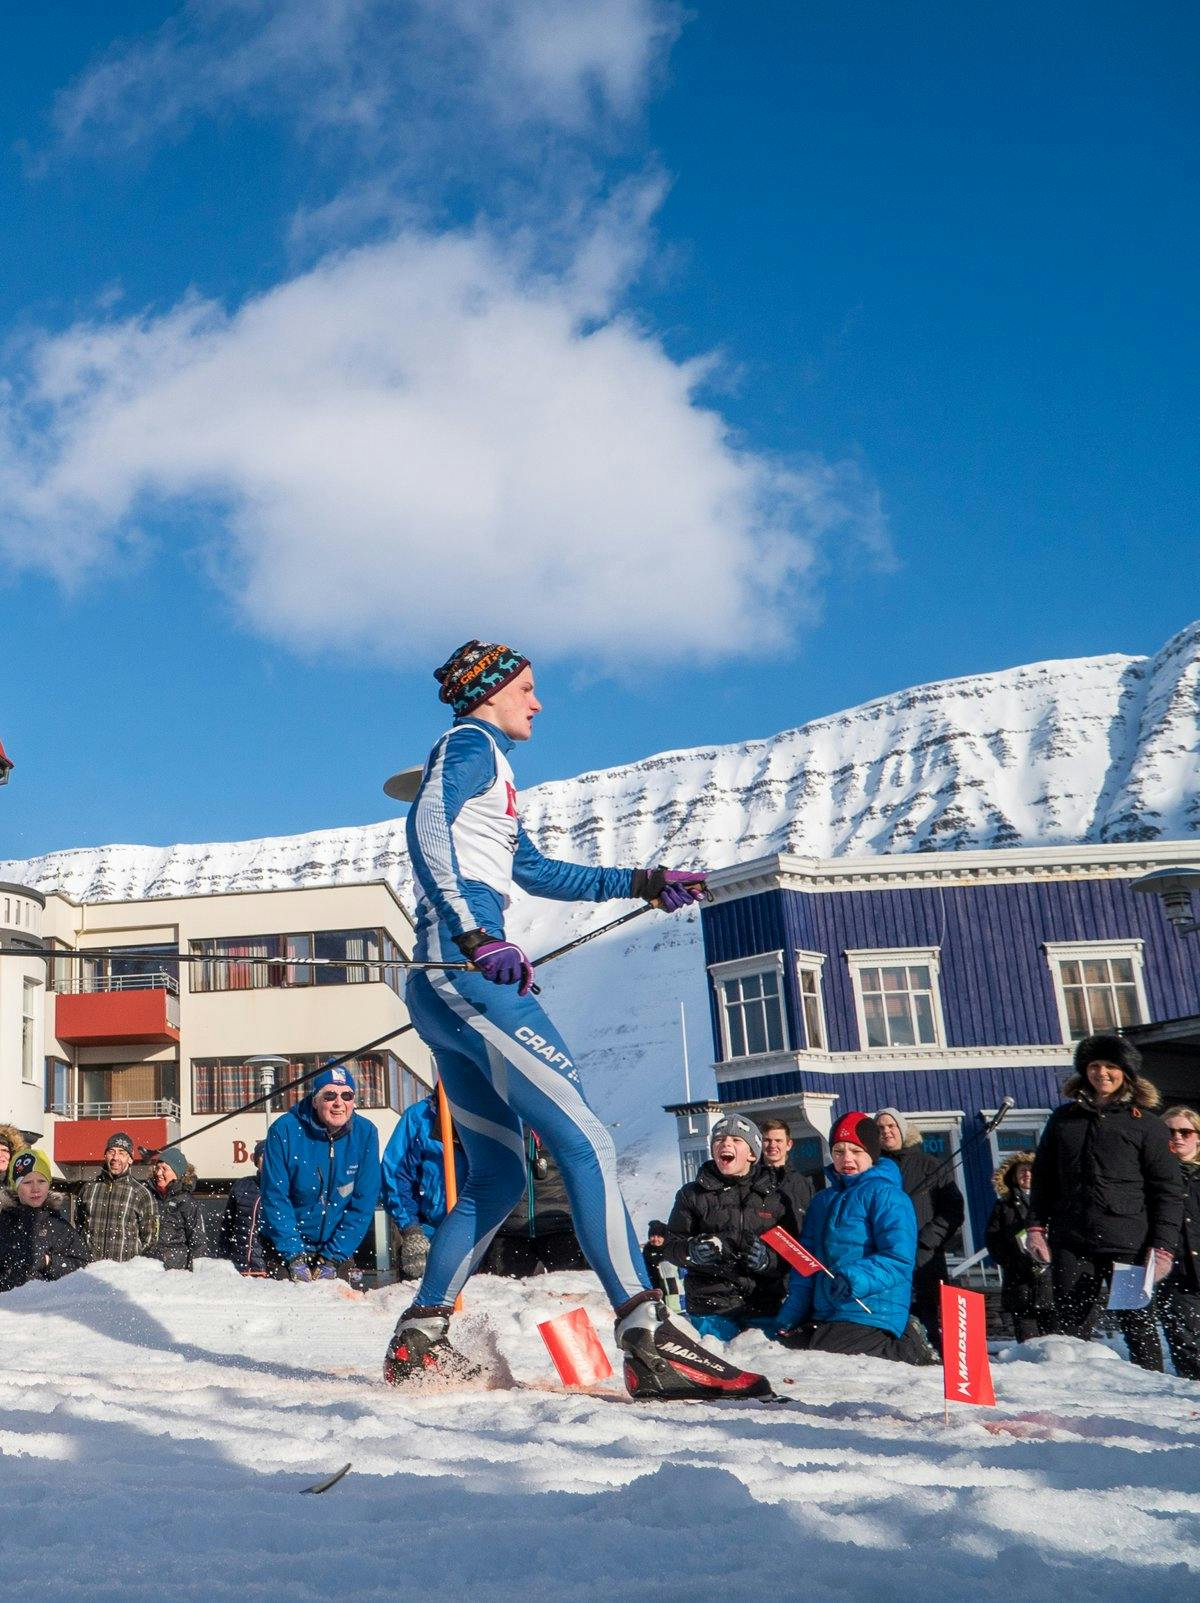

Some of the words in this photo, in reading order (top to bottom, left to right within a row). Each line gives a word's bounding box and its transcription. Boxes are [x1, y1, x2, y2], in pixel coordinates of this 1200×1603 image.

[460, 655, 491, 684] CRAFT
[514, 1026, 573, 1069] CRAFT
[957, 1294, 969, 1382] MADSHUS
